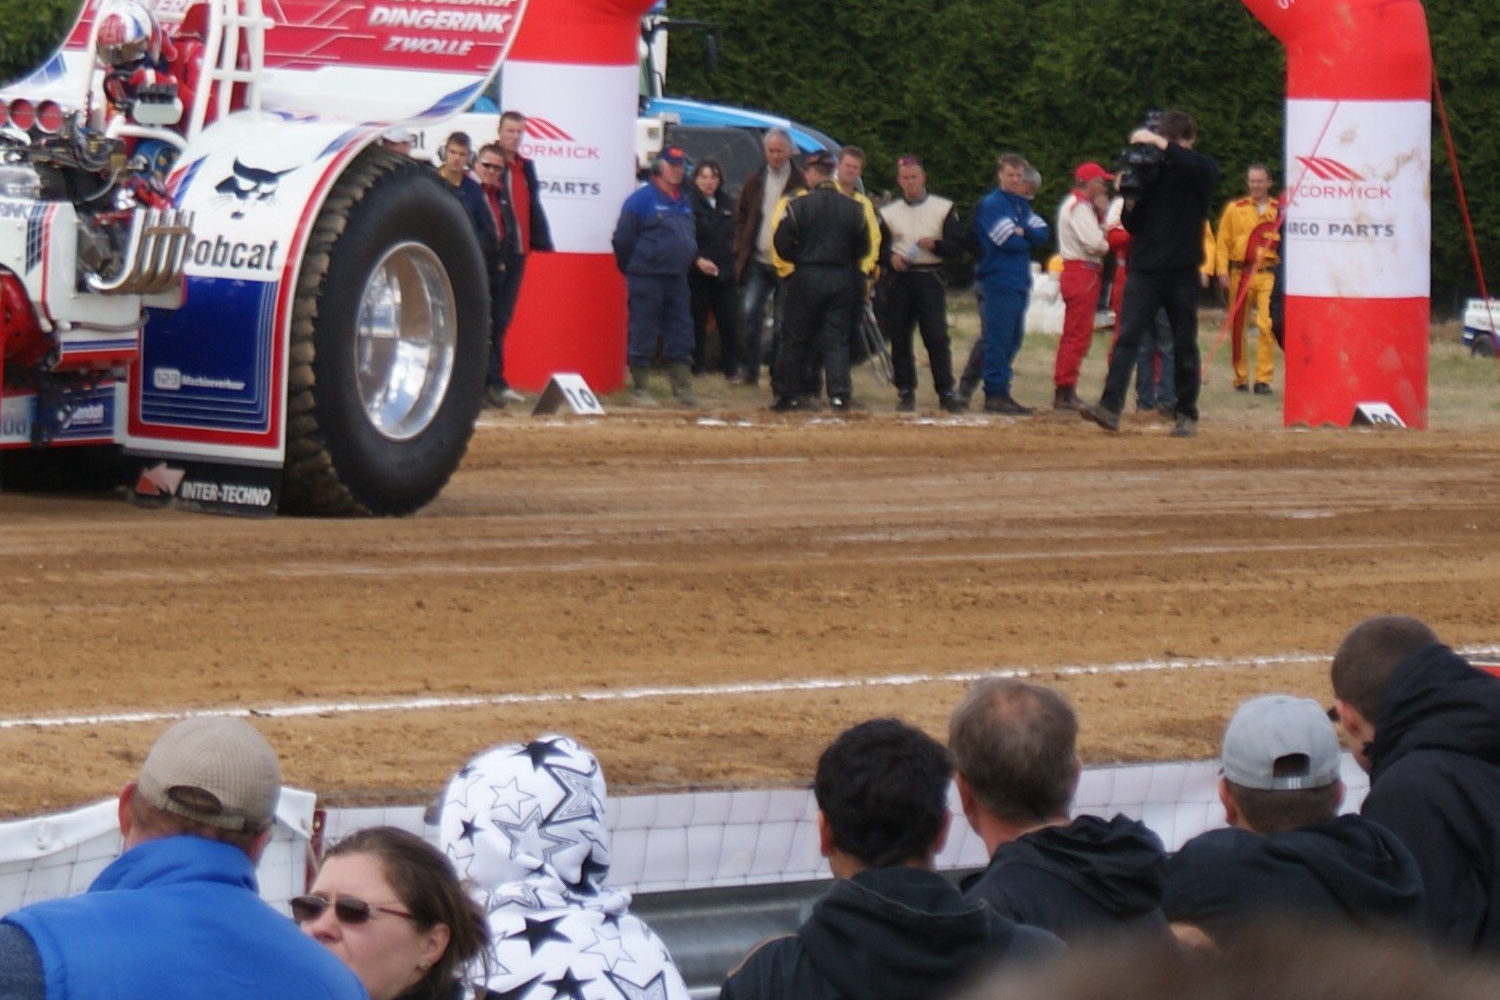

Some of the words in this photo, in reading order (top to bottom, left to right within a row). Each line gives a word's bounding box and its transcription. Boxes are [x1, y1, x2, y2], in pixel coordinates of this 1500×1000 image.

[368, 6, 513, 33] DINGERINK
[384, 36, 475, 56] ZWOLLE
[520, 143, 600, 160] ORMICK
[538, 180, 601, 195] PARTS
[1299, 184, 1393, 200] CORMICK
[1328, 223, 1395, 238] PARTS
[565, 387, 596, 409] 10
[181, 481, 272, 507] INTER-TECHNO
